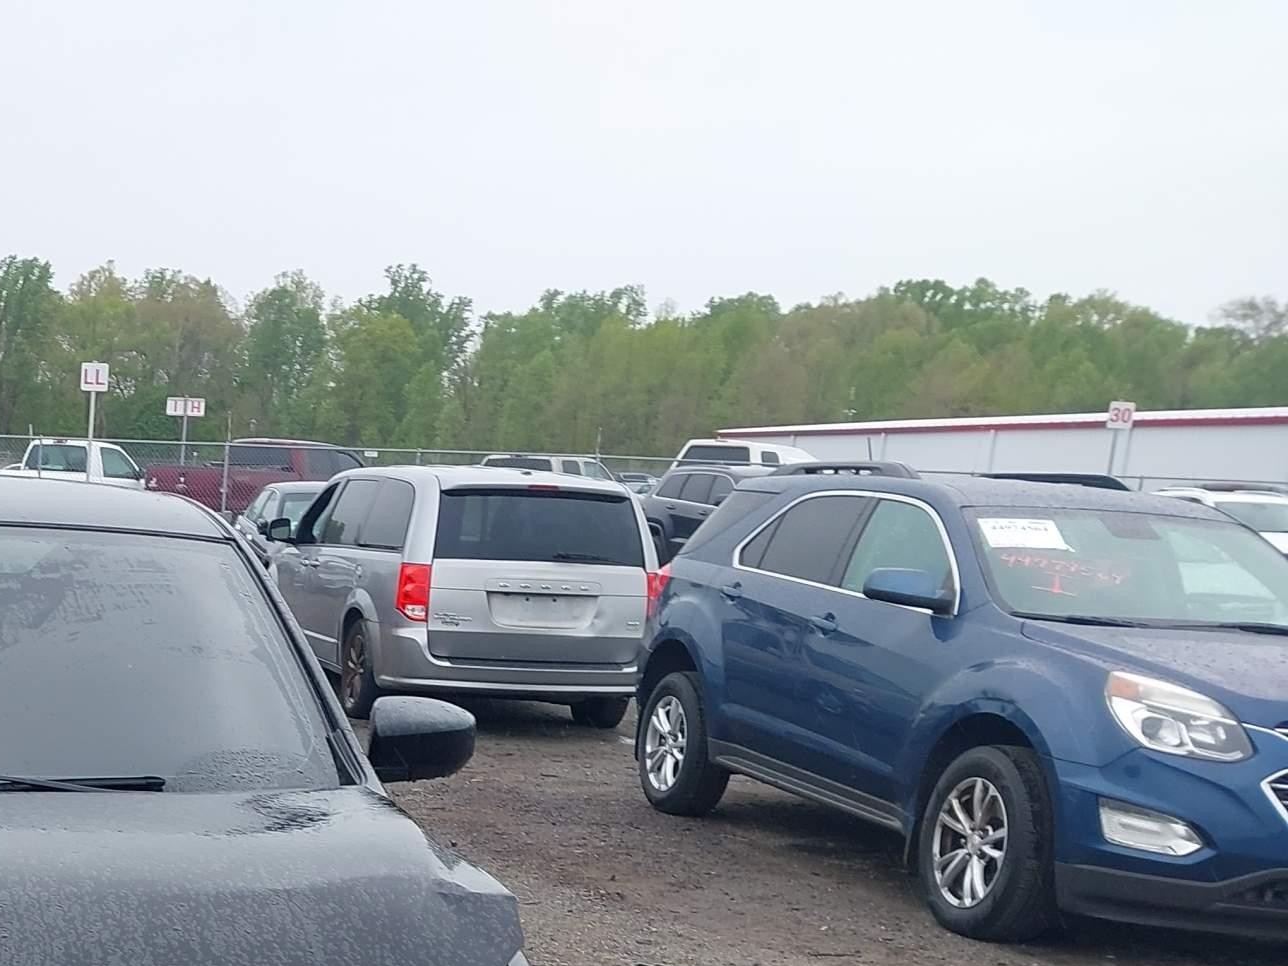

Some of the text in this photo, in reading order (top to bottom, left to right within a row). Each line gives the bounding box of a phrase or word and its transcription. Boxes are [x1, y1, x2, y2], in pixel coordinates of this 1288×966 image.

[84, 368, 106, 385] LL
[191, 400, 201, 413] H
[1110, 407, 1132, 423] 30
